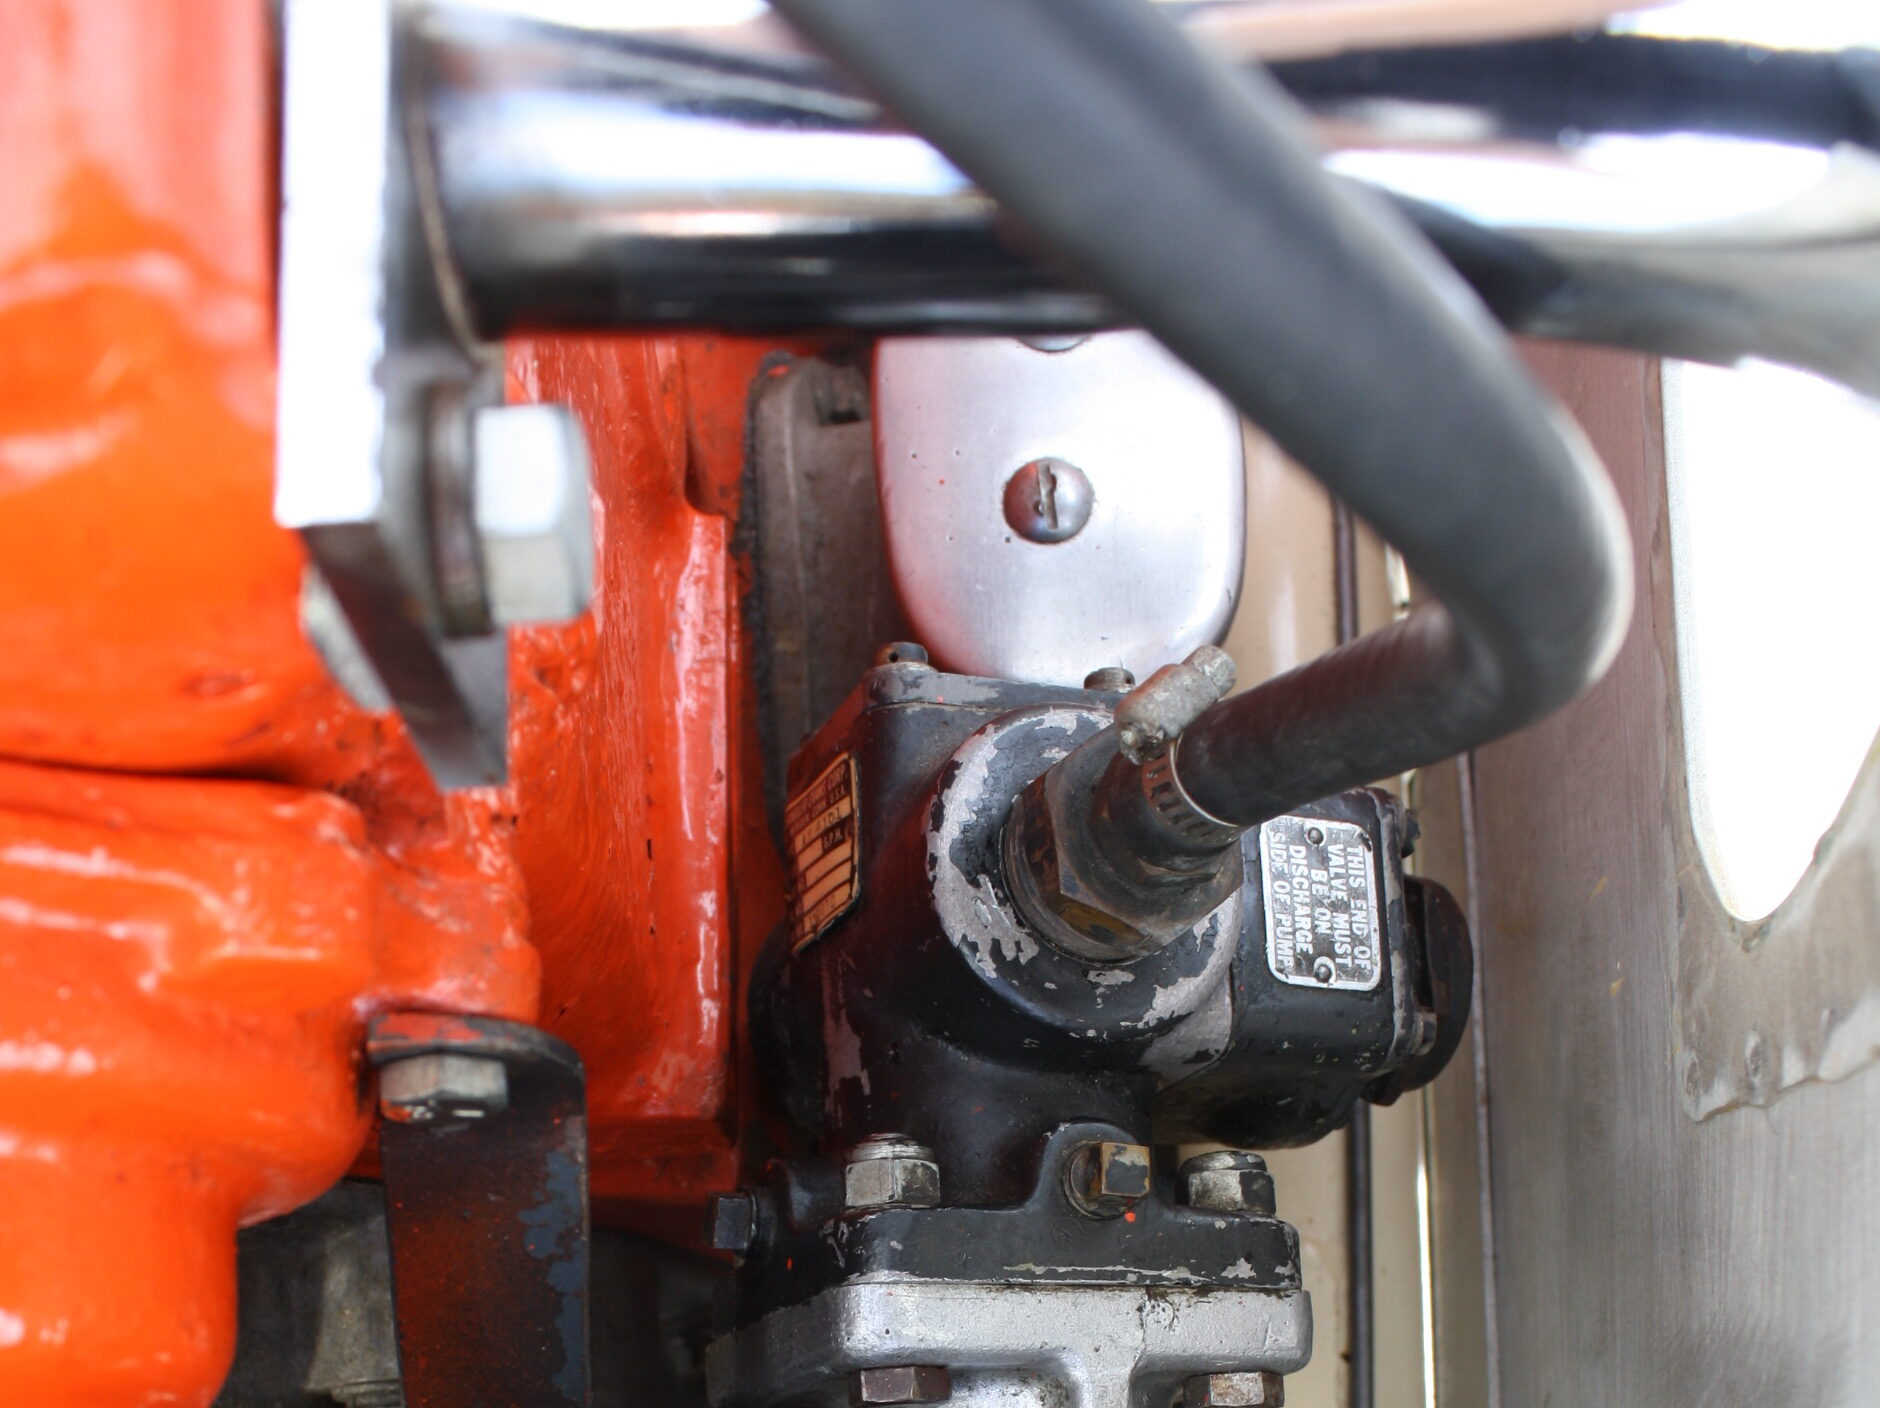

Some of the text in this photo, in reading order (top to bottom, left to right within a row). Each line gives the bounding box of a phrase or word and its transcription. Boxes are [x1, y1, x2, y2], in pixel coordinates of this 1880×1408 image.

[1269, 830, 1294, 968] SIDE OF PUMP
[1289, 845, 1313, 954] DISCHARGE
[1310, 868, 1332, 934] BE ON
[1327, 844, 1353, 968] VALVE MUST
[1346, 845, 1371, 971] THIS END OF
